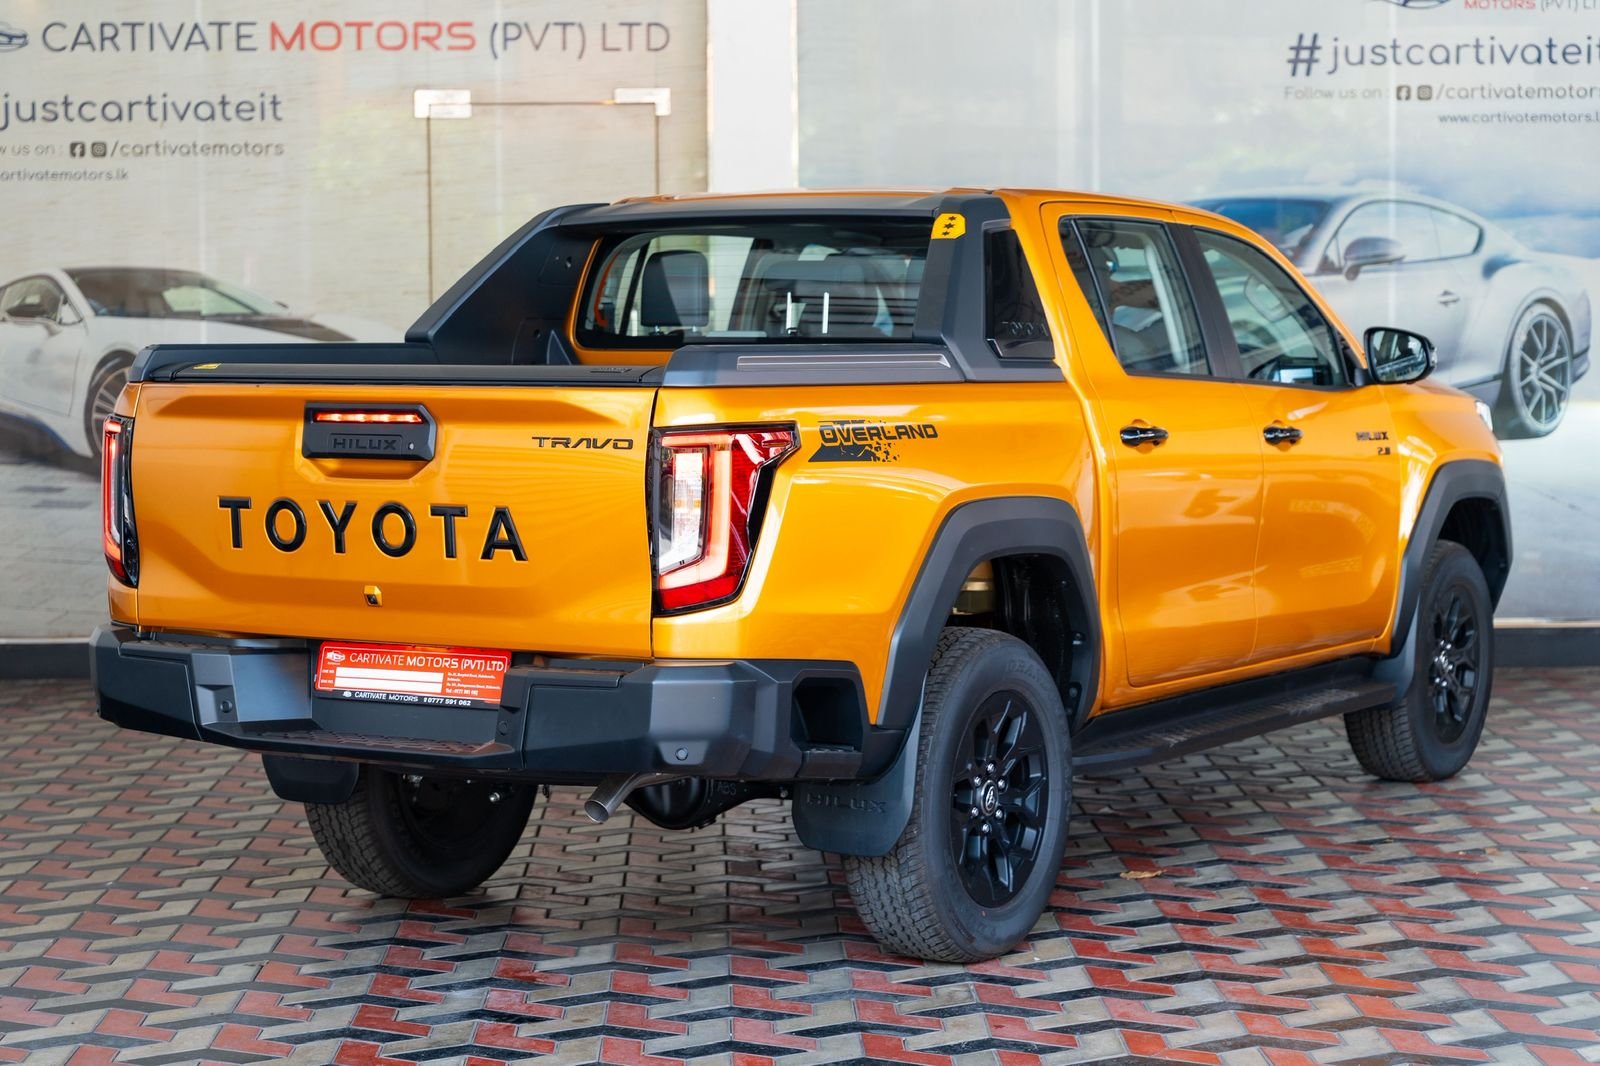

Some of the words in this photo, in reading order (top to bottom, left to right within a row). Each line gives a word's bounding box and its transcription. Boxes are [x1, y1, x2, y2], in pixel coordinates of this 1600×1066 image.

[42, 21, 258, 52] CARTIVATE
[269, 21, 476, 51] MOTORS
[489, 21, 586, 60] (PVT)
[601, 22, 670, 51] LTD
[1283, 85, 1334, 100] Follow
[1338, 88, 1359, 100] us
[11, 143, 31, 157] us
[110, 140, 285, 158] /cartivatemotors
[819, 424, 938, 443] OVERLAND
[332, 436, 398, 452] HILUX
[531, 435, 635, 451] TRAVO
[218, 495, 530, 563] TOYOTA
[350, 652, 405, 667] CARTIVATE
[406, 655, 459, 669] MOTORS
[460, 658, 486, 672] (PVT)
[486, 660, 505, 672] LTD
[354, 691, 387, 701] CARTIVATE
[388, 693, 419, 702] MOTORS
